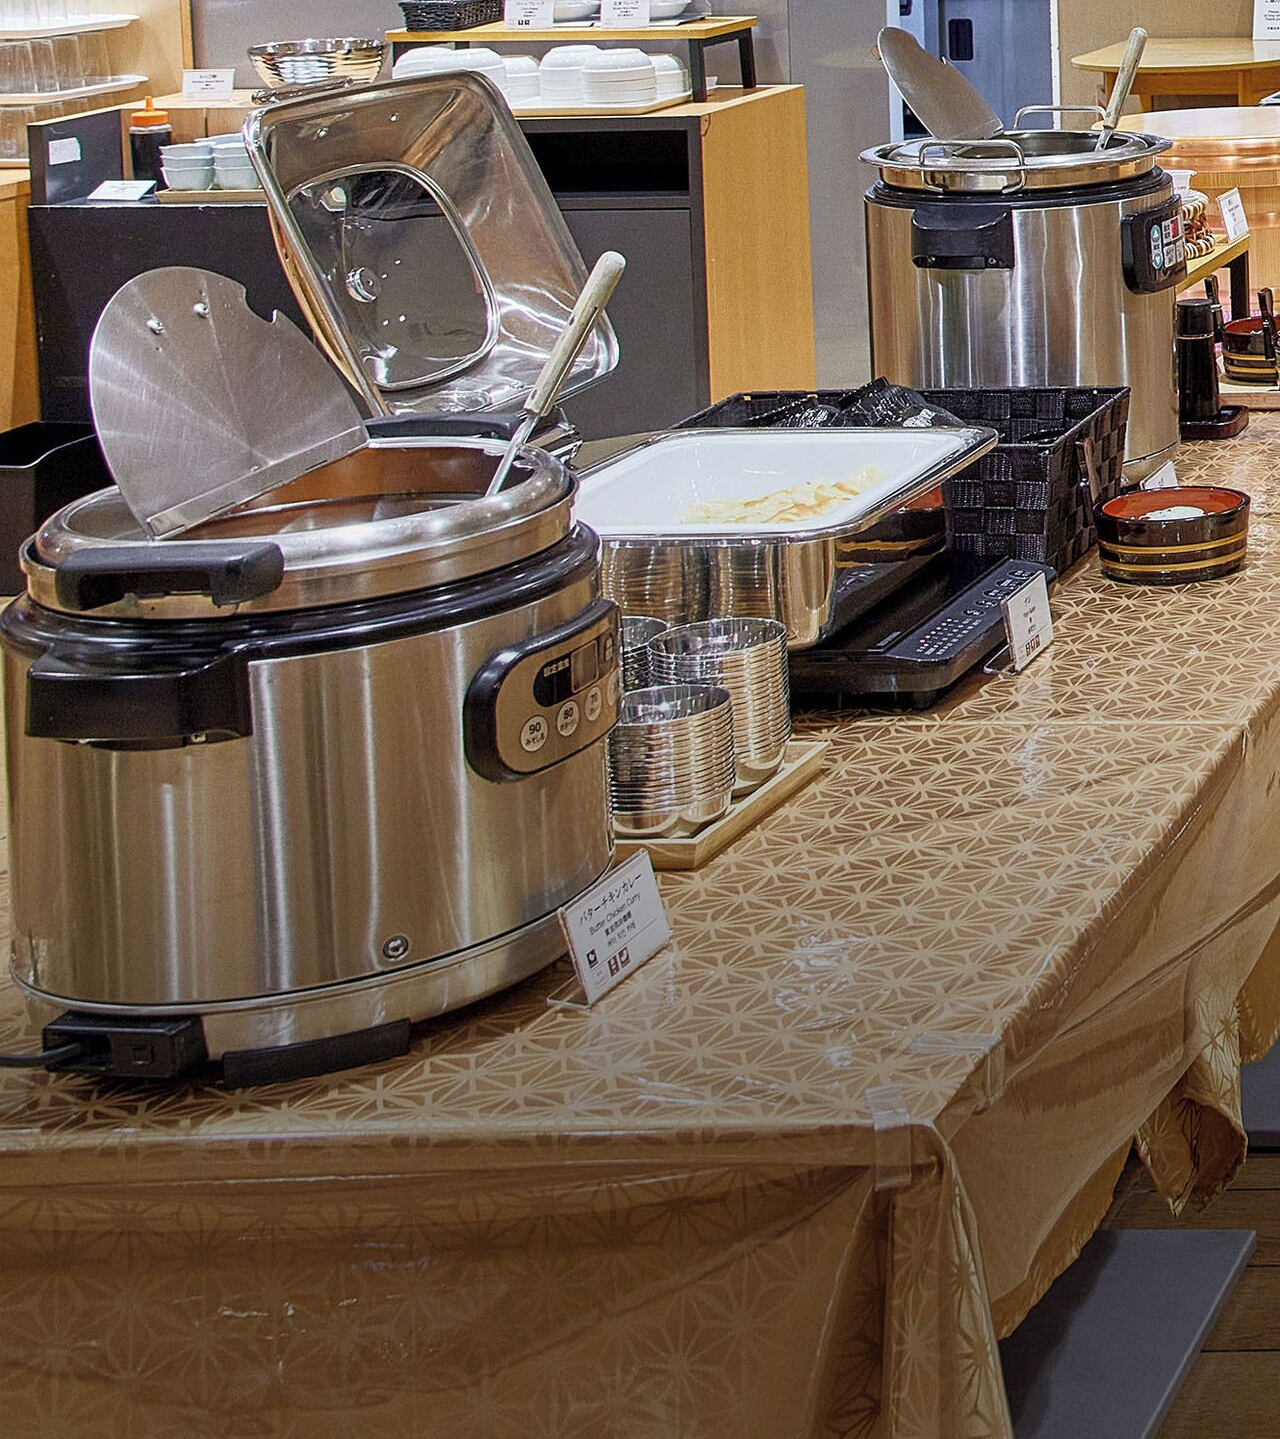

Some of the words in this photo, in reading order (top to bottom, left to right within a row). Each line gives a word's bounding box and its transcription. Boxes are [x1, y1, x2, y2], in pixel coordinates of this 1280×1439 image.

[563, 707, 574, 719] 80
[529, 722, 541, 734] 90
[580, 874, 642, 926] バターチキンカレー
[589, 919, 606, 935] Butter
[606, 904, 627, 921] Chicken
[626, 893, 641, 907] Curry
